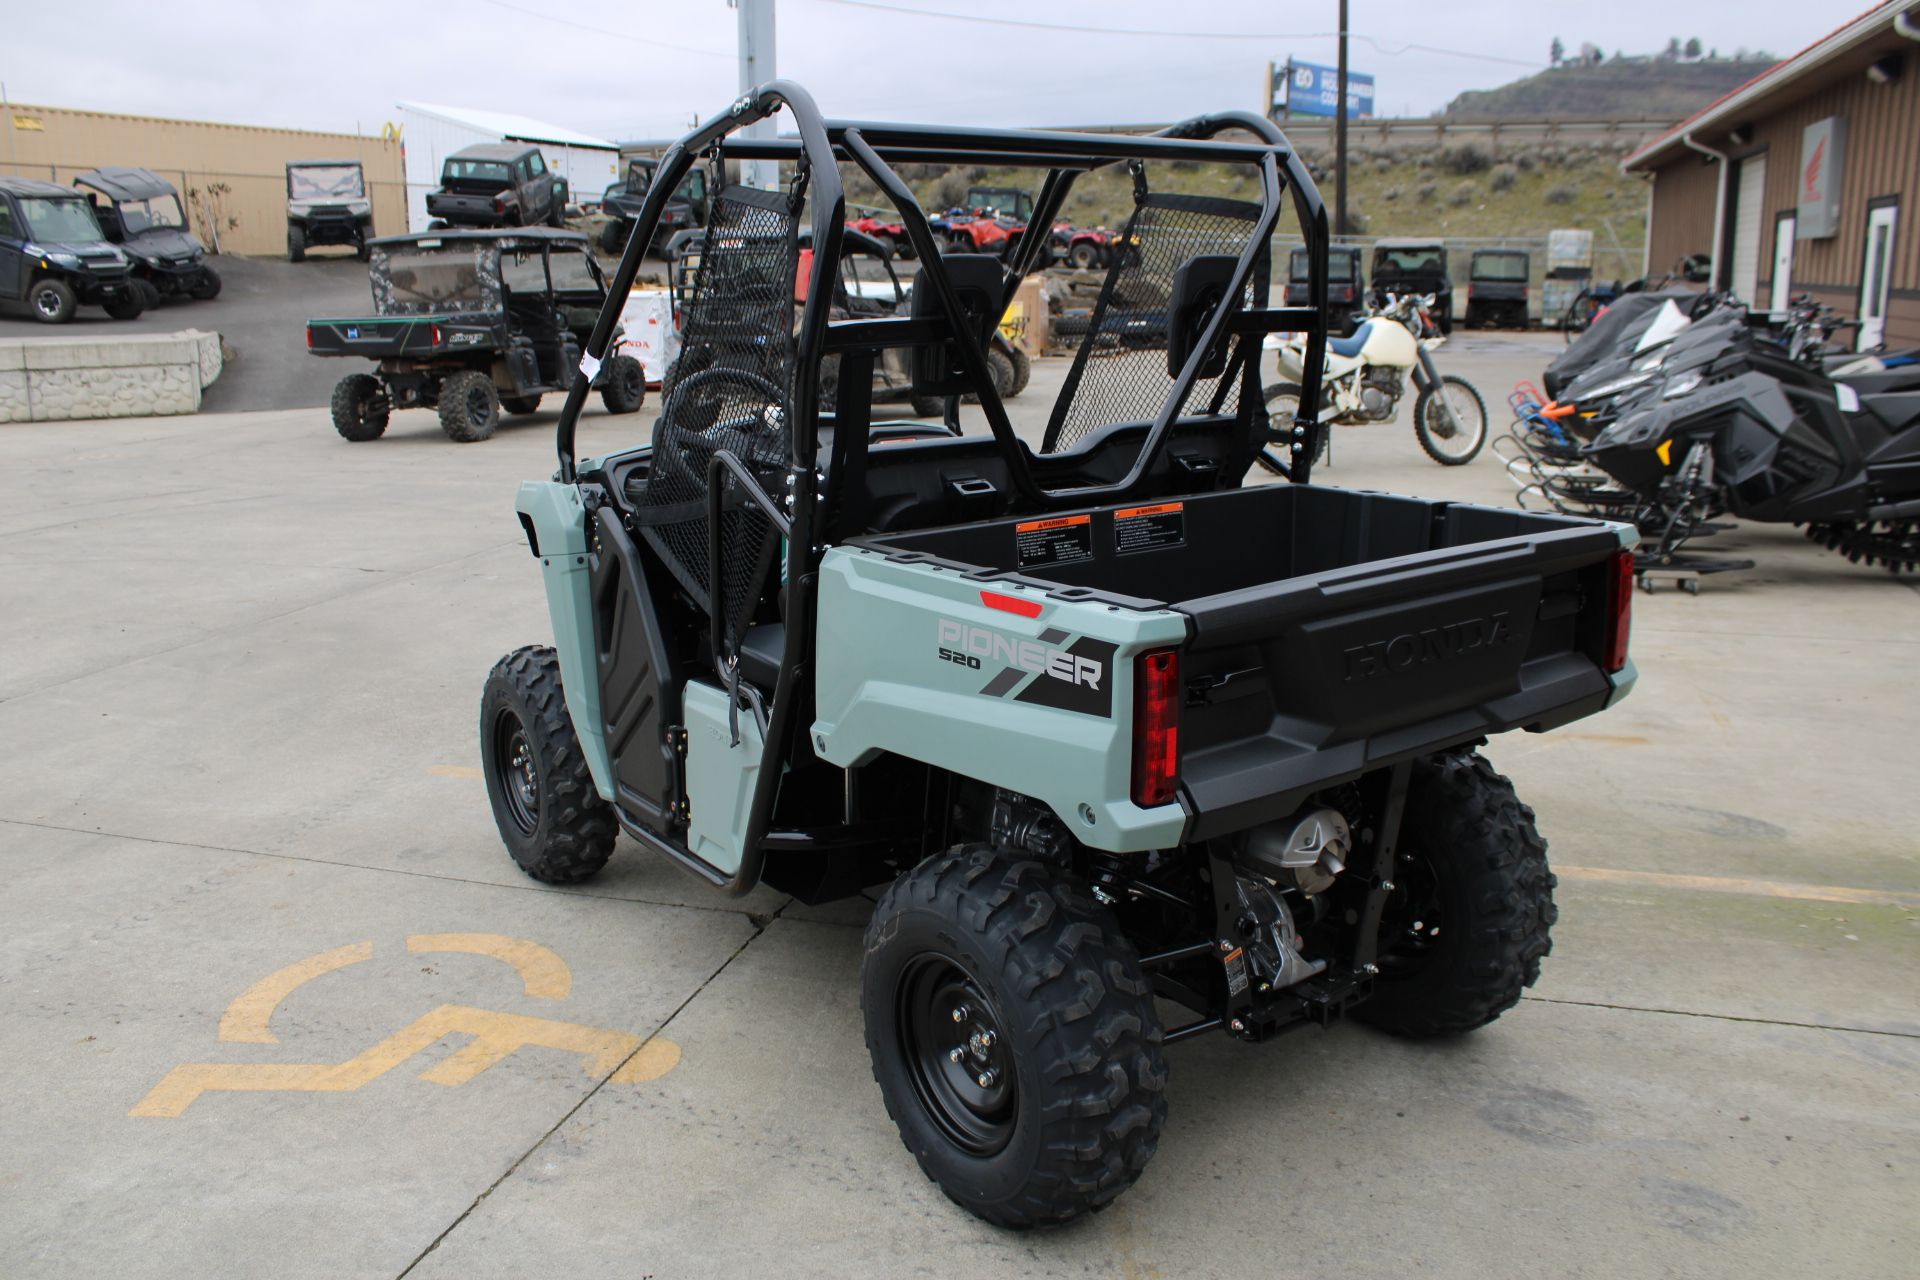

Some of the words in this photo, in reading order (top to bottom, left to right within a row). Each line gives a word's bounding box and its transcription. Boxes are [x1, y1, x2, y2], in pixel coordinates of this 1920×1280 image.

[1042, 519, 1069, 528] WARNING
[937, 618, 1102, 691] PIONEER
[938, 647, 981, 670] 520
[1343, 610, 1511, 682] HONDA
